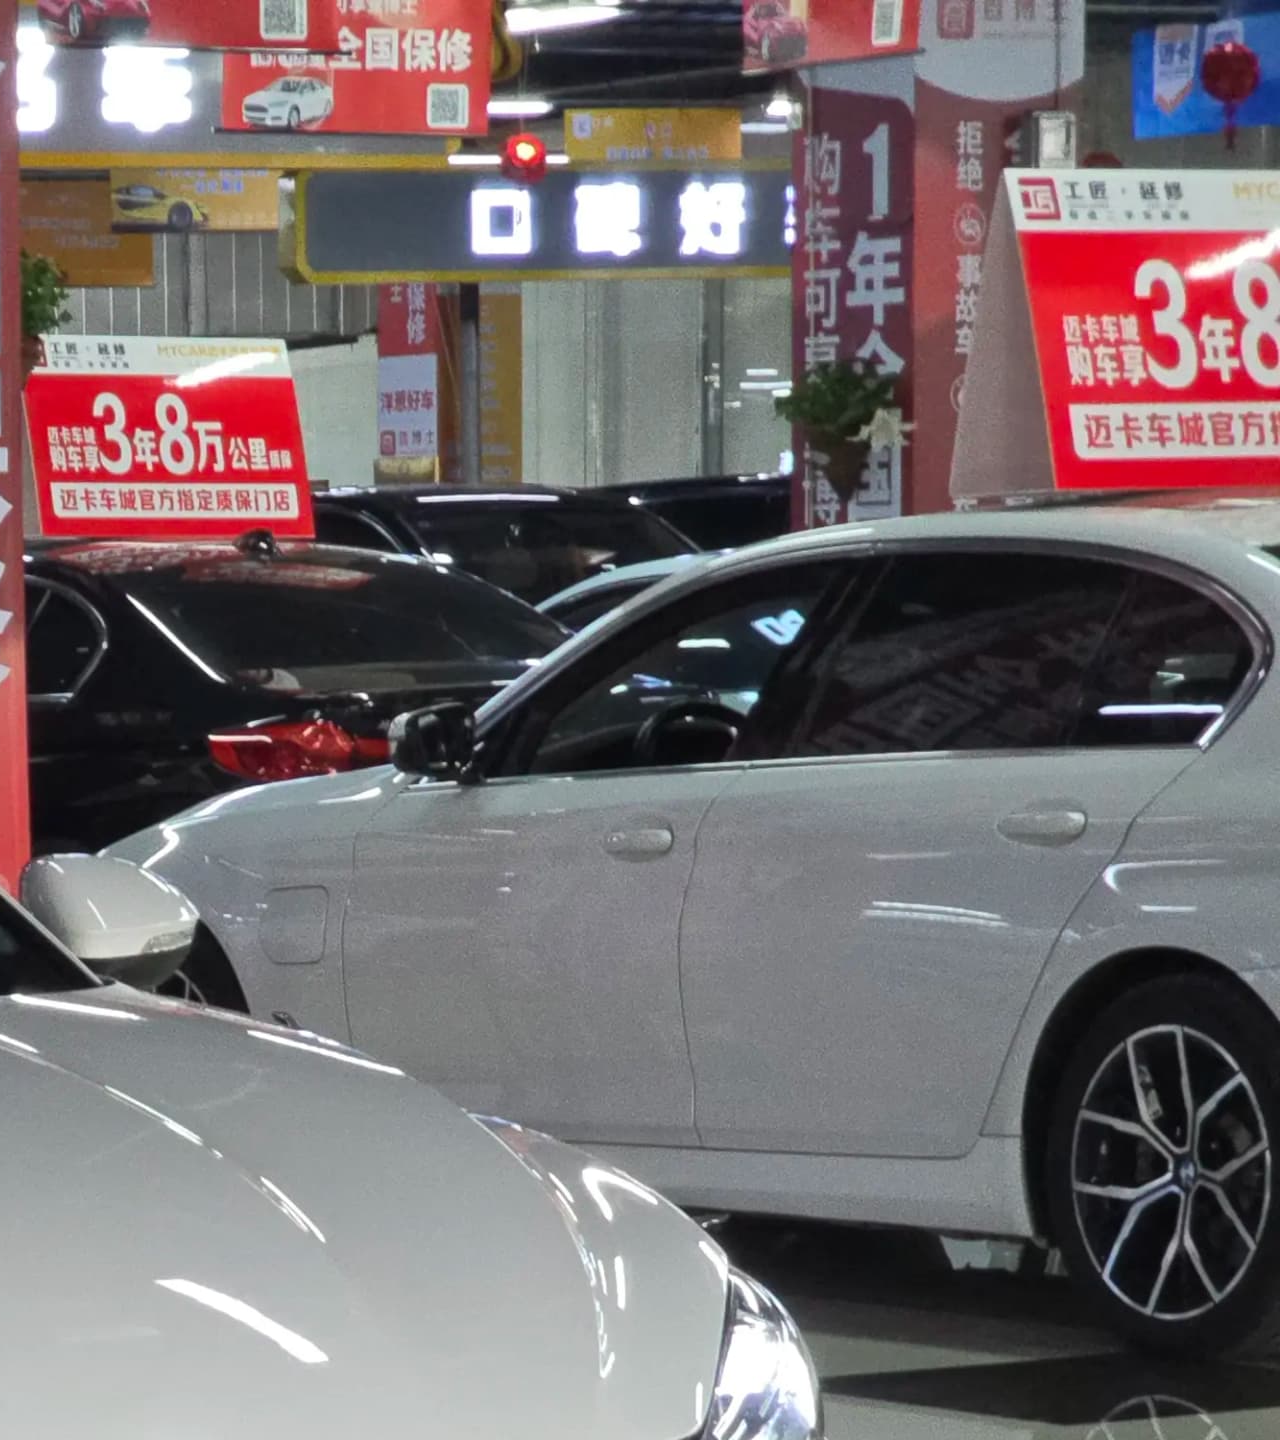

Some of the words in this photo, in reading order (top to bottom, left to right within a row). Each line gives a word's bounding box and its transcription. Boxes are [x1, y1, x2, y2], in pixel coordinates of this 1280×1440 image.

[330, 26, 473, 72] 全国保修
[471, 181, 797, 258] 口碑好
[1062, 315, 1140, 343] 迈卡车城
[1067, 345, 1146, 387] 购车享
[59, 487, 291, 513] 迈卡车城官方指定质保门店
